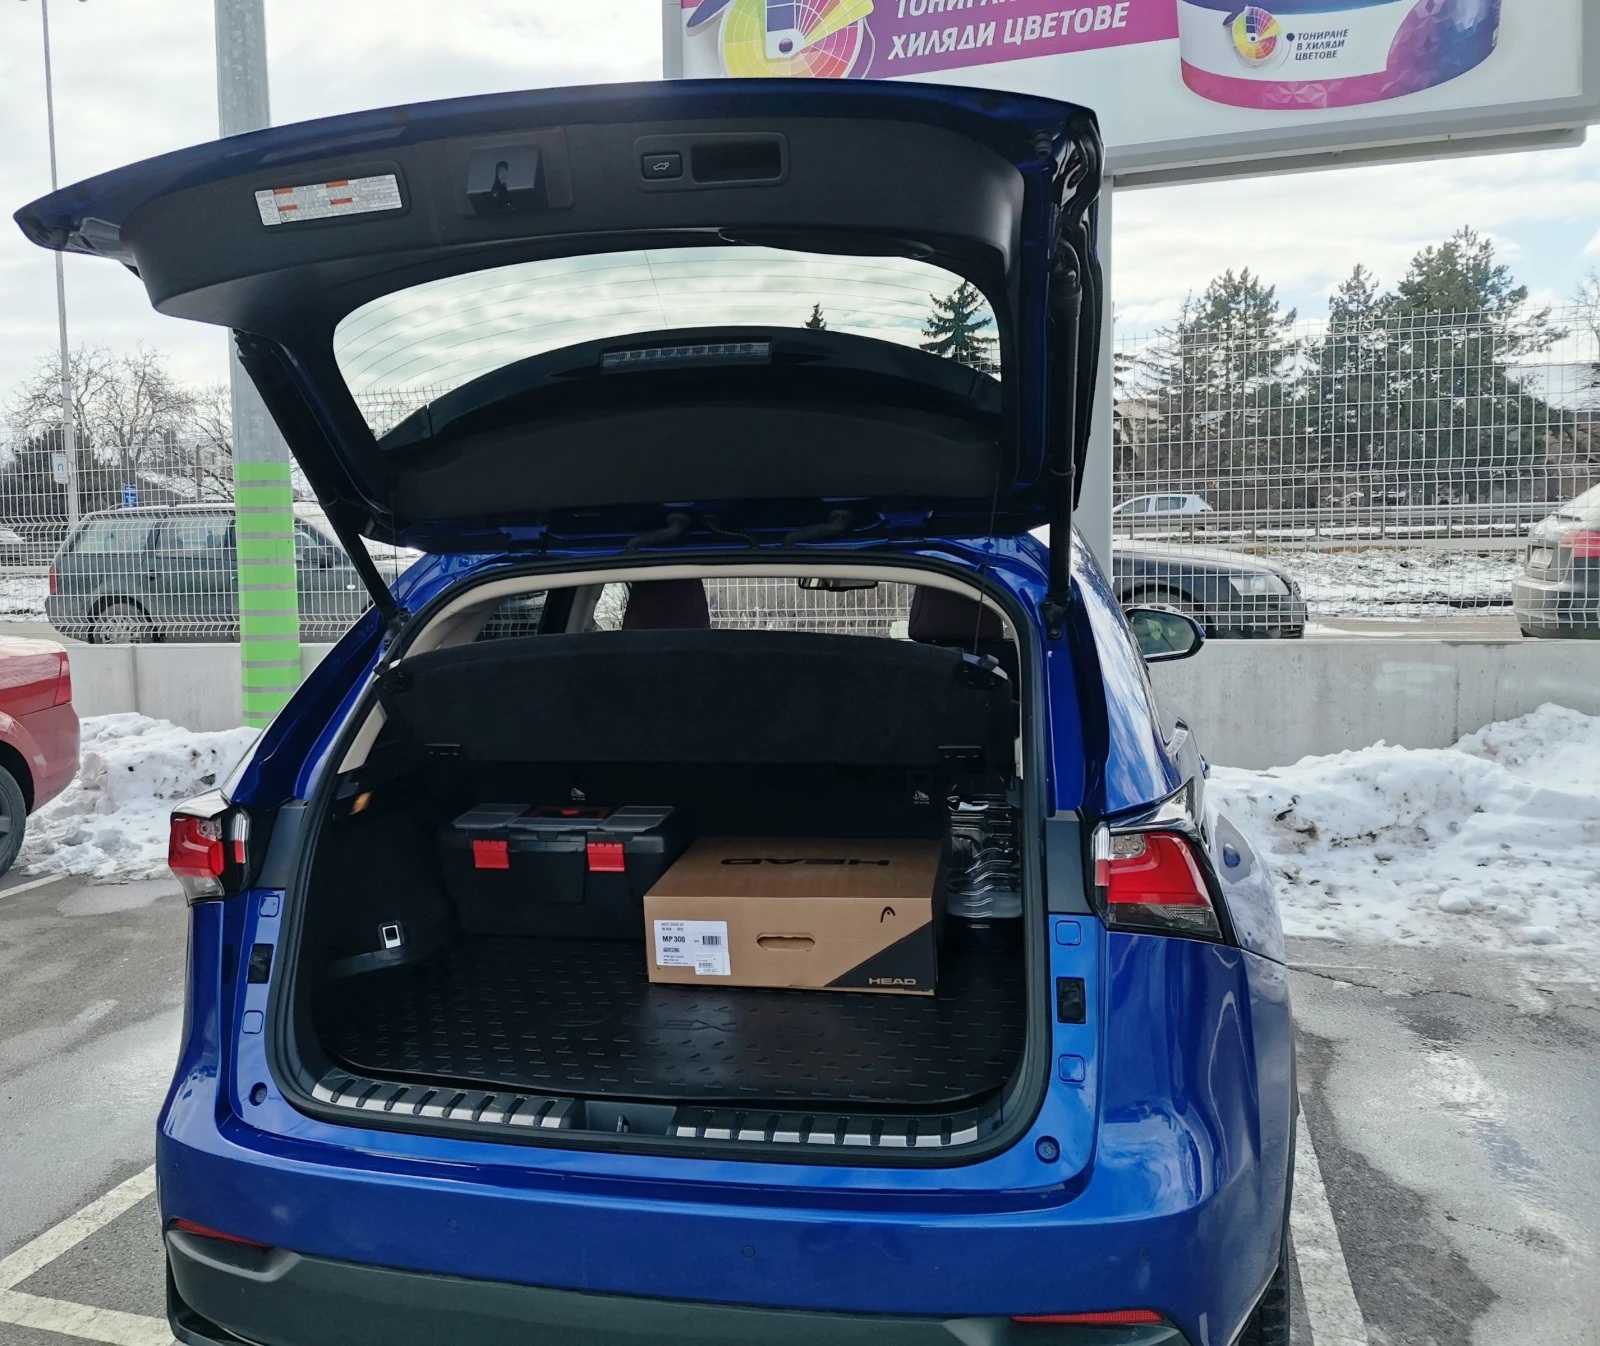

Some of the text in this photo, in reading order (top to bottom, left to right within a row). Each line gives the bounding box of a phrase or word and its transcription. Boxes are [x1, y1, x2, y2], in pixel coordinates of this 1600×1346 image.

[887, 21, 997, 60] ХИЛЯДИ
[1003, 2, 1130, 46] ЦВЕТОВЕ
[1298, 29, 1349, 41] ТОНИРАНЕ
[1296, 39, 1345, 51] В ХИЛЯДИ
[1295, 50, 1338, 61] ЦВЕТОВЕ
[720, 858, 890, 866] HEAD
[868, 977, 917, 986] HEAD
